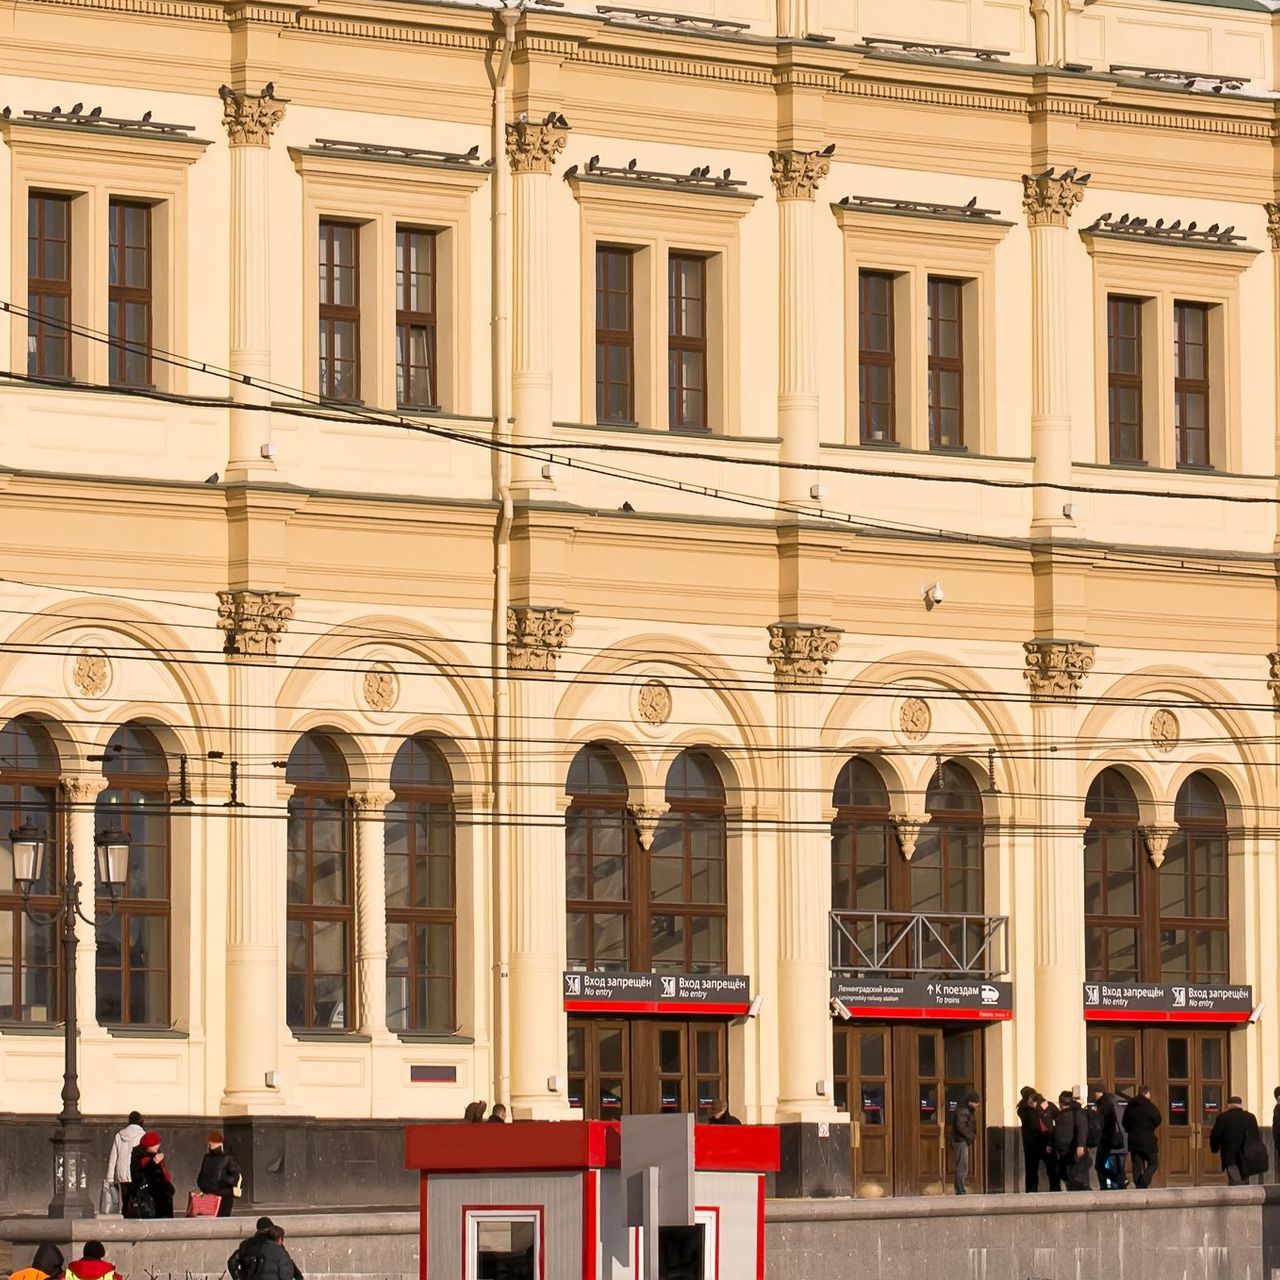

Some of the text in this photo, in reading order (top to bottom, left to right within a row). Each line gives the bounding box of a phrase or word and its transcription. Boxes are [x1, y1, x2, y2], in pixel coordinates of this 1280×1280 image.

[584, 975, 652, 989] Вход запрещён
[679, 978, 746, 991] Вход запрещён
[595, 989, 613, 998] entry
[838, 984, 883, 994] Ленинградский
[935, 983, 979, 996] К поездам
[1102, 986, 1164, 999] Вход запрещён
[1188, 987, 1249, 1000] Вход запрещён
[690, 991, 708, 999] entry
[1112, 998, 1129, 1007] entry
[1198, 1000, 1214, 1009] entry
